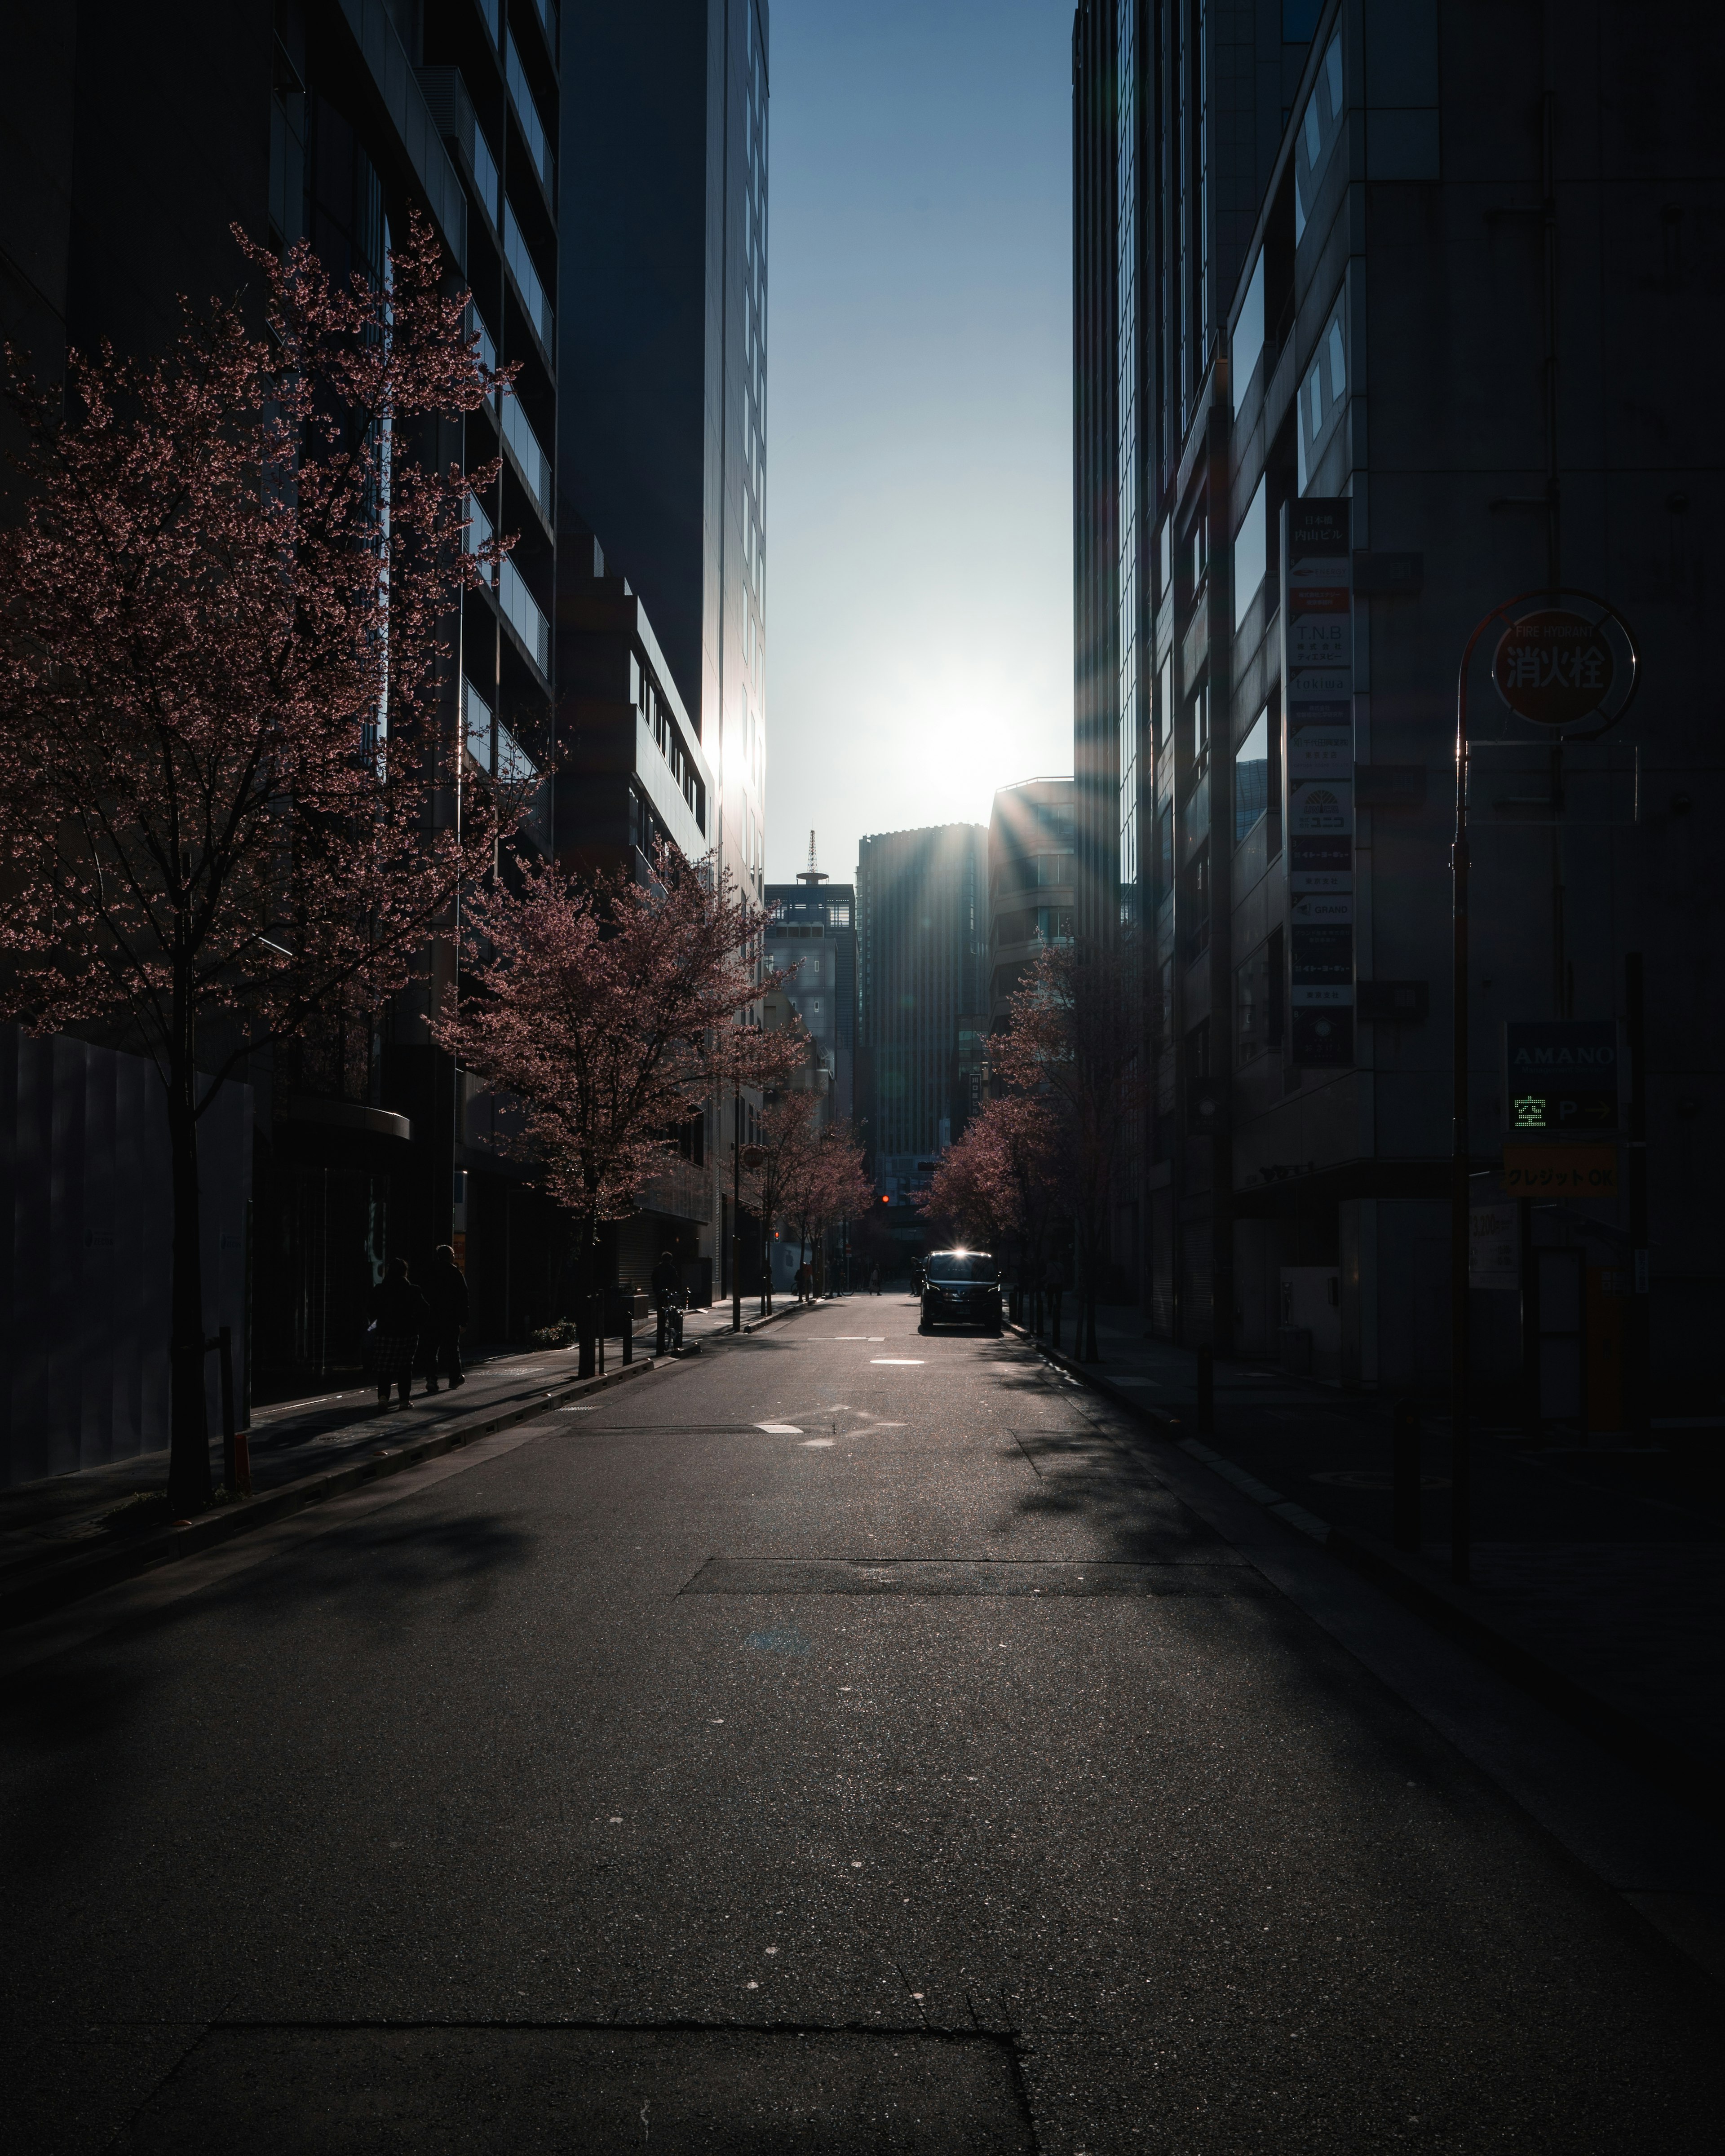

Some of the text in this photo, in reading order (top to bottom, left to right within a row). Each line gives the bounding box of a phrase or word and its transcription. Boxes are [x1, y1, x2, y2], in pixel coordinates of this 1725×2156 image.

[1305, 515, 1333, 525] 日本橋
[1295, 529, 1344, 541] 内山ビル
[1296, 626, 1342, 640] T.N.B
[1516, 626, 1595, 638] FIRE HYDRANT
[1297, 653, 1342, 661] ティエヌビー
[1506, 645, 1606, 689] 消火栓
[1296, 678, 1344, 689] tokiwa
[1315, 906, 1348, 914] GRAND
[1513, 1046, 1615, 1065] AMANO
[1522, 1066, 1573, 1074] Management
[1514, 1096, 1546, 1127] 空
[1559, 1100, 1578, 1121] P
[1508, 1166, 1614, 1186] クレジット OK
